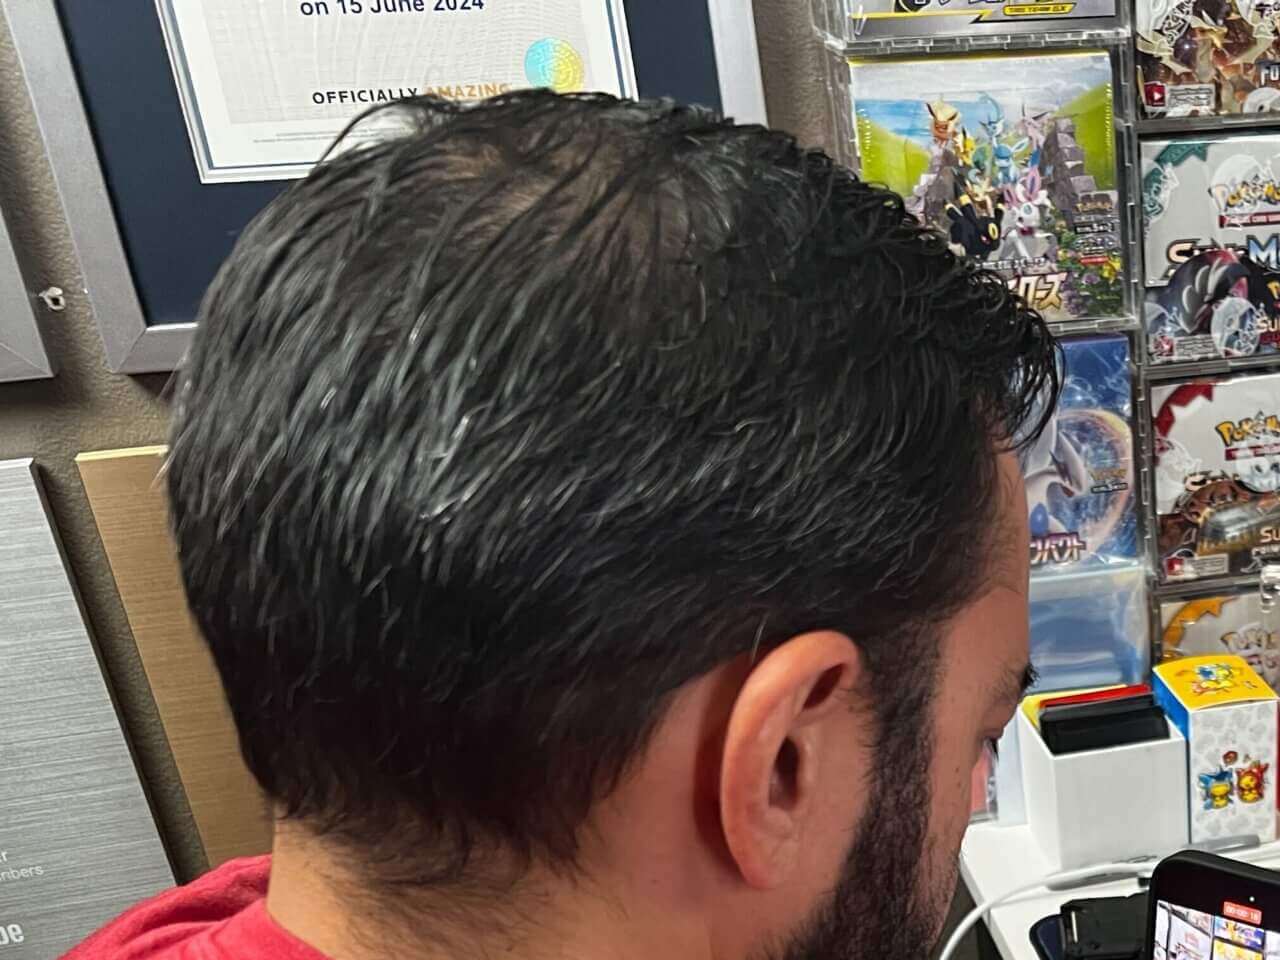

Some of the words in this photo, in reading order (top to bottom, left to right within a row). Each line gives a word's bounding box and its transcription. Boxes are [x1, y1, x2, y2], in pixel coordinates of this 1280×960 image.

[301, 1, 329, 15] on
[337, 0, 363, 14] 15
[371, 0, 425, 14] June
[311, 87, 418, 105] OFFICIALLY
